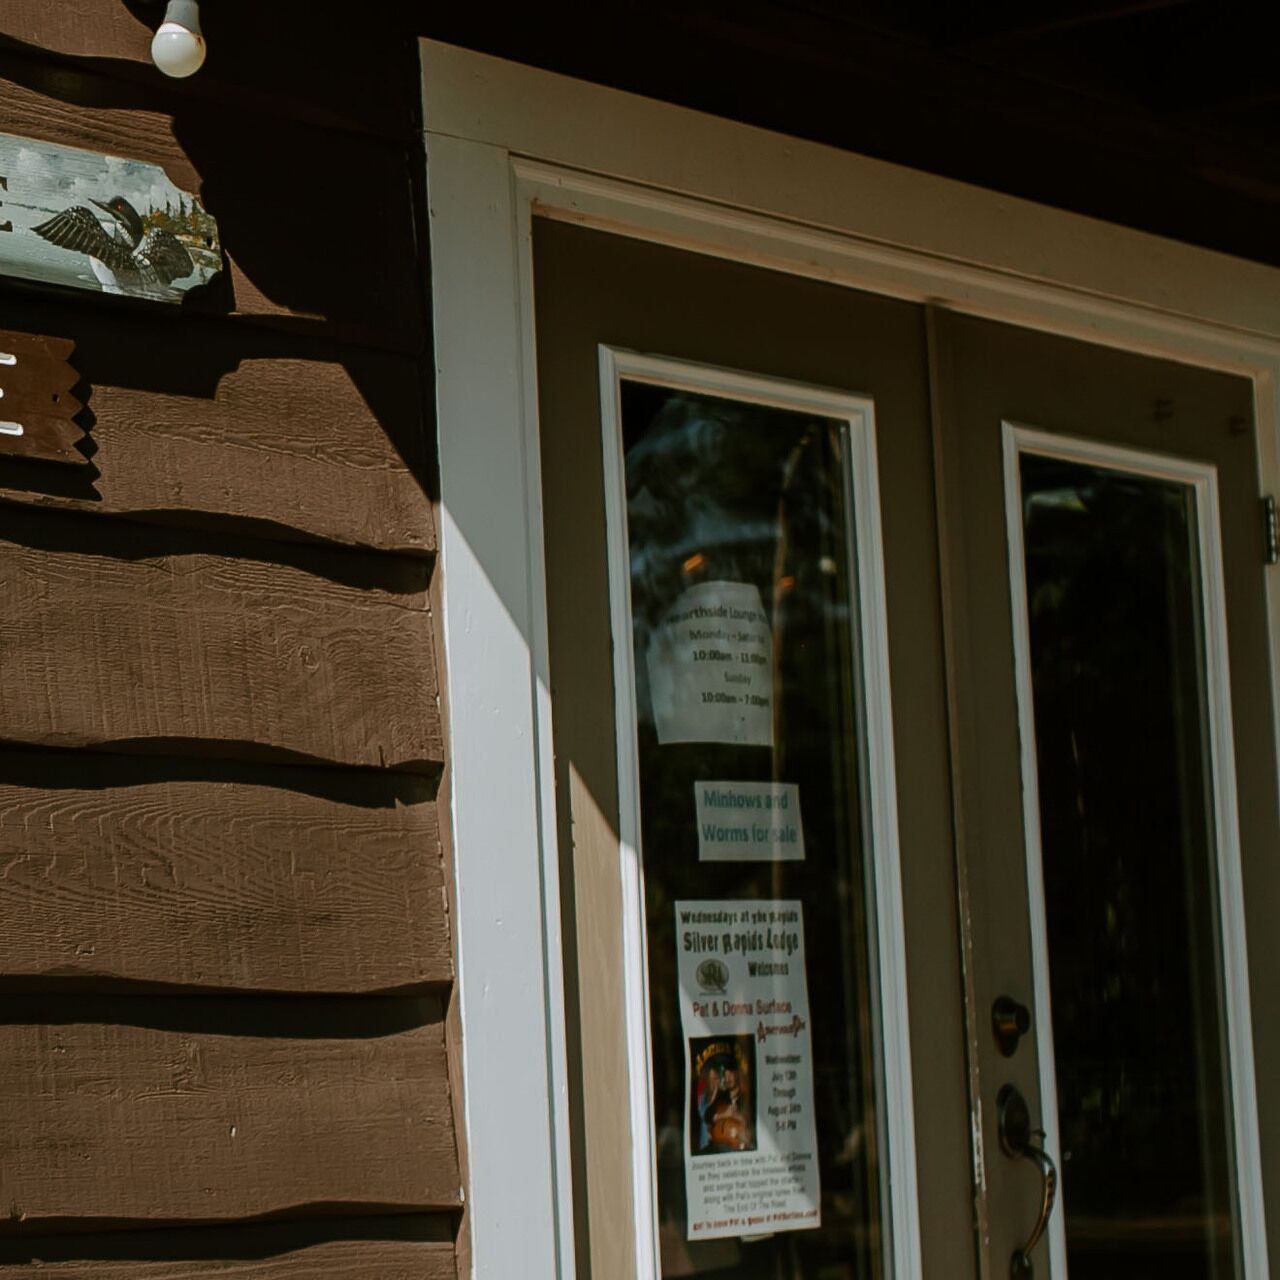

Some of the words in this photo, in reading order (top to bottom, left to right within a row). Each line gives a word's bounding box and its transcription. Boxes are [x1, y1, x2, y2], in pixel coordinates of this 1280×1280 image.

[724, 672, 751, 685] Sunday
[703, 824, 749, 842] Worms
[752, 823, 768, 842] for
[773, 825, 798, 842] ale
[683, 931, 719, 952] Silver
[722, 930, 763, 956] Rapids
[767, 928, 799, 956] Lodge
[692, 1001, 709, 1017] Pat
[711, 1001, 719, 1017] &
